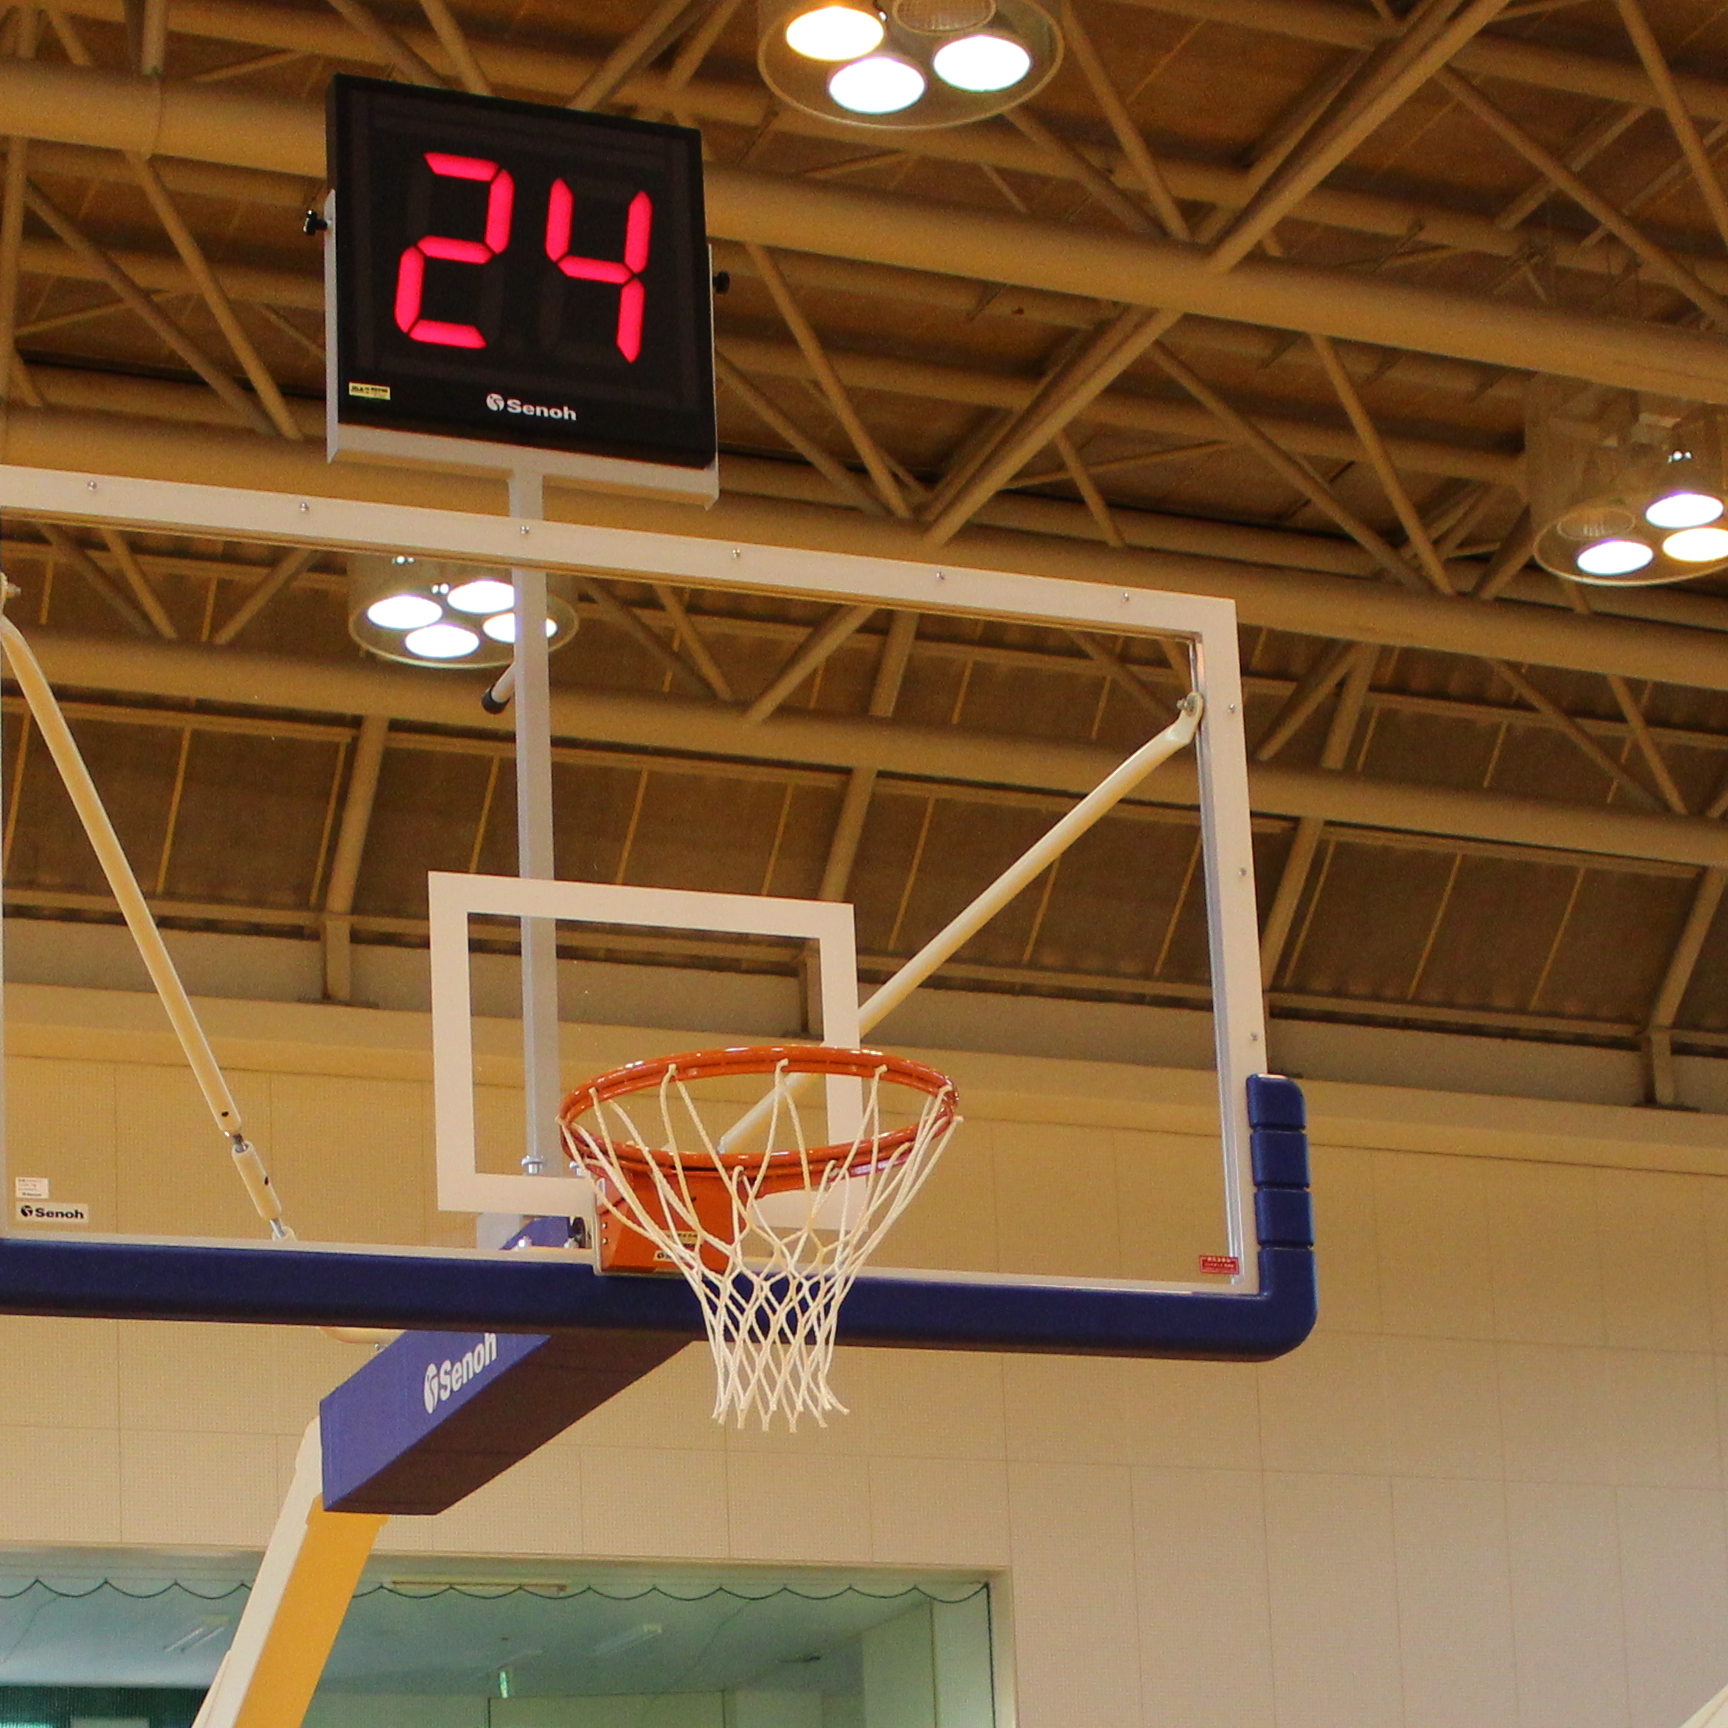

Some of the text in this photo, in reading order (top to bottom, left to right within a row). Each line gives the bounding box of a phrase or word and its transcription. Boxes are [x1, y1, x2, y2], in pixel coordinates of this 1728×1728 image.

[393, 151, 653, 363] 24
[506, 398, 578, 421] Senoh
[35, 1207, 85, 1220] Senoh
